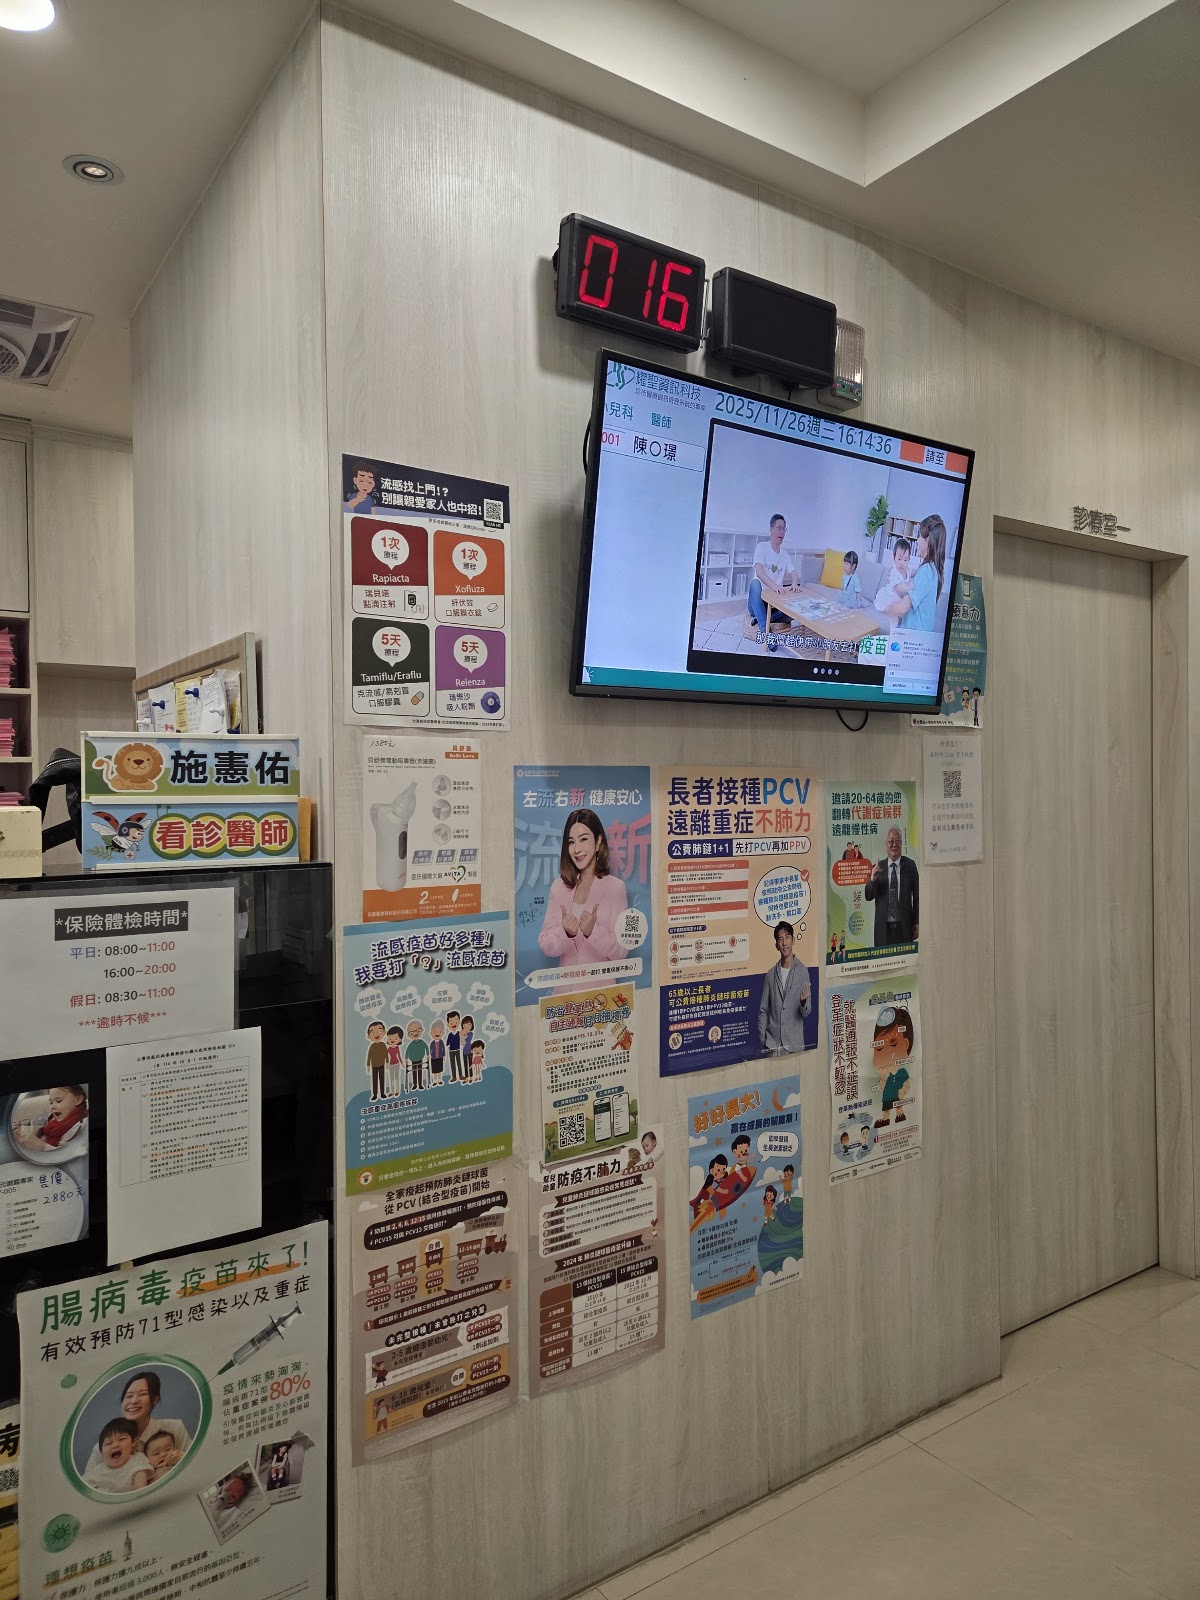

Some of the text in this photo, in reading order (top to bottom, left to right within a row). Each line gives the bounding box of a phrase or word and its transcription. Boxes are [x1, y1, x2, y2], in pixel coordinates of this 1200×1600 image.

[579, 235, 692, 331] 016
[651, 412, 672, 429] 醫師
[925, 449, 945, 465] 請至
[380, 536, 400, 550] 1次
[460, 548, 479, 562] 1次
[372, 573, 410, 584] Rapiacta
[455, 584, 485, 594] Xofluza
[381, 633, 401, 646] 5天
[461, 641, 479, 653] 5天
[360, 670, 422, 683] Tamiflu/Eraflu
[455, 677, 486, 687] Relenza
[170, 750, 290, 785] 施憲佑
[522, 787, 643, 807] 左流右新 健康安心
[667, 776, 811, 806] 長者接種PCV
[832, 805, 902, 821] 翻轉代謝症候群
[667, 808, 811, 836] 遠離重症不肺力
[832, 823, 878, 836] 遠離慢性病
[156, 818, 289, 850] 看診醫師
[671, 840, 807, 856] 公費肺鏈1+1 先打PCV再加PPV
[371, 931, 491, 959] 流感疫苗好多種!
[103, 963, 176, 979] 16:00~20:00
[693, 1090, 761, 1133] 好好長大!
[396, 1199, 416, 1212] PCV
[40, 1240, 309, 1335] 腸病毒疫苗來了!
[40, 1274, 311, 1362] 有效預防71型感染以及重症
[270, 1372, 311, 1401] 80%
[45, 1551, 114, 1584] 理想疫苗
